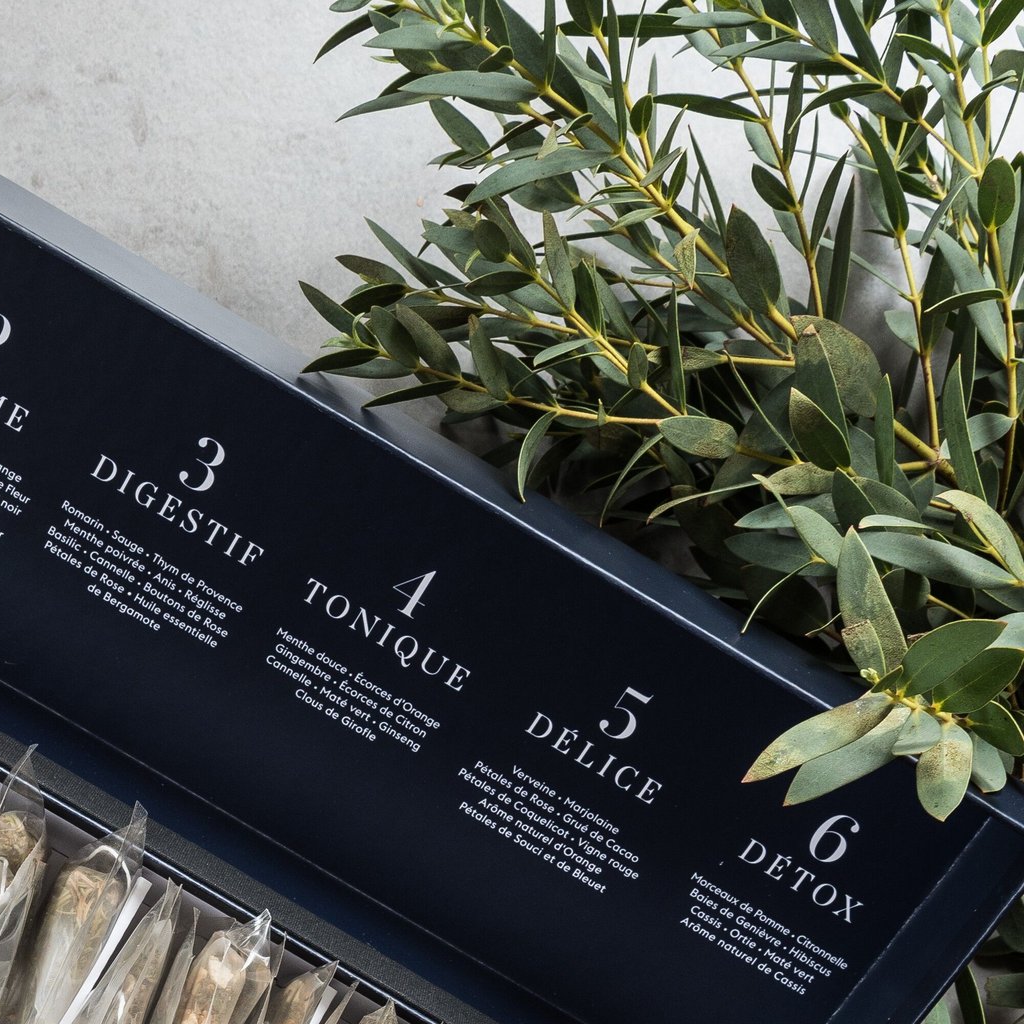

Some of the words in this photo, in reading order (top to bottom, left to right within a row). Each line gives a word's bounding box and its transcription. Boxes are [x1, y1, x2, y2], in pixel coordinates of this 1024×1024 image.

[0, 500, 22, 515] noir
[5, 483, 31, 504] Fleur
[179, 436, 226, 491] 3
[90, 453, 264, 566] DIGESTIF
[44, 540, 82, 568] Pétales
[83, 565, 98, 577] de
[99, 572, 125, 593] Rose
[133, 593, 161, 615] Huile
[163, 612, 217, 648] essentielle
[47, 525, 81, 551] Basilic
[89, 551, 135, 583] Cannelle
[143, 581, 185, 613] Boutons
[187, 610, 201, 622] de
[202, 617, 228, 638] Rose
[61, 500, 104, 531] Romarin
[111, 529, 144, 554] Sauge
[152, 552, 179, 575] Thym
[180, 572, 195, 584] de
[196, 579, 243, 613] Provence
[63, 518, 104, 548] Menthe
[104, 545, 145, 572] poivrée
[152, 572, 176, 590] Anis
[184, 589, 226, 619] Réglisse
[392, 570, 437, 619] 4
[87, 584, 101, 596] de
[102, 591, 160, 631] Bergamote
[303, 577, 471, 692] TONIQUE
[266, 655, 312, 687] Cannelle
[319, 686, 348, 708] Maté
[350, 705, 371, 722] vert
[378, 721, 421, 752] Ginseng
[275, 643, 331, 681] Gingembre
[338, 679, 378, 709] Écorces
[379, 706, 393, 718] de
[395, 714, 426, 738] Citron
[276, 627, 315, 655] Menthe
[316, 652, 347, 674] douce
[354, 672, 392, 701] Écorces
[393, 698, 440, 729] d'Orange
[295, 688, 323, 711] Clous
[325, 708, 339, 720] de
[341, 716, 376, 741] Girofle
[599, 686, 654, 740] 5
[513, 765, 556, 797] Verveine
[563, 797, 619, 834] Marjolaine
[525, 711, 663, 805] DÉLICE
[458, 767, 496, 795] Pétales
[497, 793, 512, 805] de
[513, 801, 569, 839] Coquelicot
[578, 837, 607, 860] Vigne
[608, 858, 639, 879] rouge
[458, 801, 497, 829] Pétales
[498, 826, 512, 838] de
[513, 834, 544, 856] Souci
[543, 853, 556, 864] et
[556, 861, 571, 872] de
[572, 868, 606, 893] Bleuet
[474, 760, 512, 788] Pétales
[513, 786, 528, 797] de
[529, 793, 555, 813] Rose
[563, 813, 589, 833] Grué
[589, 830, 604, 842] de
[605, 838, 639, 863] Cacao
[478, 798, 514, 822] Arôme
[514, 819, 554, 845] naturel
[553, 843, 602, 874] d'Orange
[809, 814, 860, 863] 6
[690, 872, 740, 905] Morceaux
[739, 902, 753, 914] de
[753, 909, 790, 935] Pomme
[796, 935, 848, 969] Citronnelle
[737, 837, 864, 924] DÉTOX
[680, 917, 716, 941] Arôme
[717, 939, 758, 965] naturel
[757, 963, 772, 974] de
[773, 971, 806, 995] Cassis
[689, 888, 718, 910] Baies
[719, 907, 734, 919] de
[735, 915, 781, 947] Genièvre
[788, 946, 831, 977] Hibiscus
[690, 905, 722, 929] Cassis
[729, 928, 756, 949] Ortie
[763, 948, 792, 969] Maté
[793, 966, 814, 983] vert
